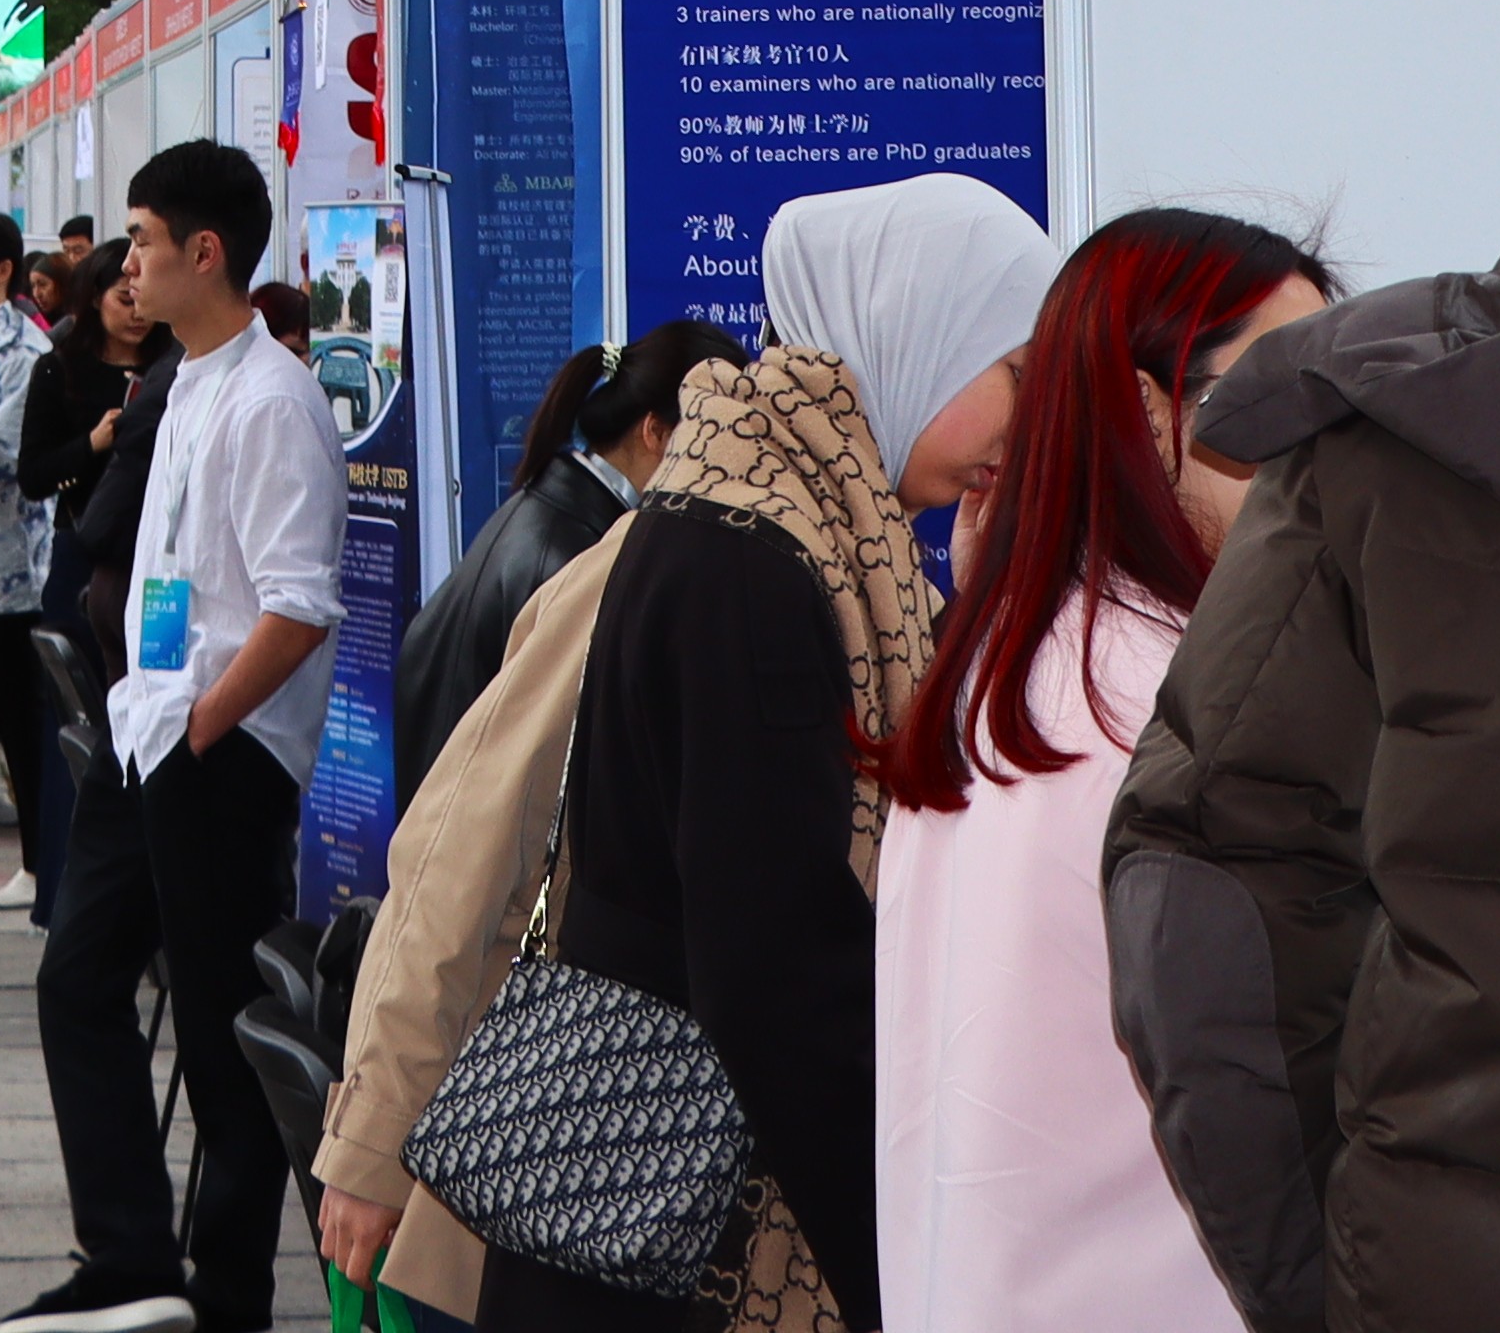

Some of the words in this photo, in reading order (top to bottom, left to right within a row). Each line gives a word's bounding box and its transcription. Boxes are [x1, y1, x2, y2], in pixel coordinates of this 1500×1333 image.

[676, 6, 688, 23] 3
[695, 5, 770, 23] trainers
[776, 4, 816, 21] who
[823, 7, 855, 21] are
[861, 3, 955, 24] nationally
[679, 44, 850, 66] 有国家级考官10人
[679, 76, 702, 93] 10
[709, 75, 811, 92] examiners
[817, 74, 857, 91] who
[864, 76, 895, 90] are
[902, 72, 996, 93] nationally
[1003, 75, 1045, 89] reco
[679, 112, 870, 136] 90%教师为博士学历
[680, 145, 723, 163] 90%
[730, 145, 750, 162] of
[755, 144, 841, 162] teachers
[847, 147, 879, 161] are
[886, 143, 927, 161] PhD
[934, 141, 1032, 164] graduates
[683, 254, 759, 277] About
[347, 461, 379, 488] 科技大学
